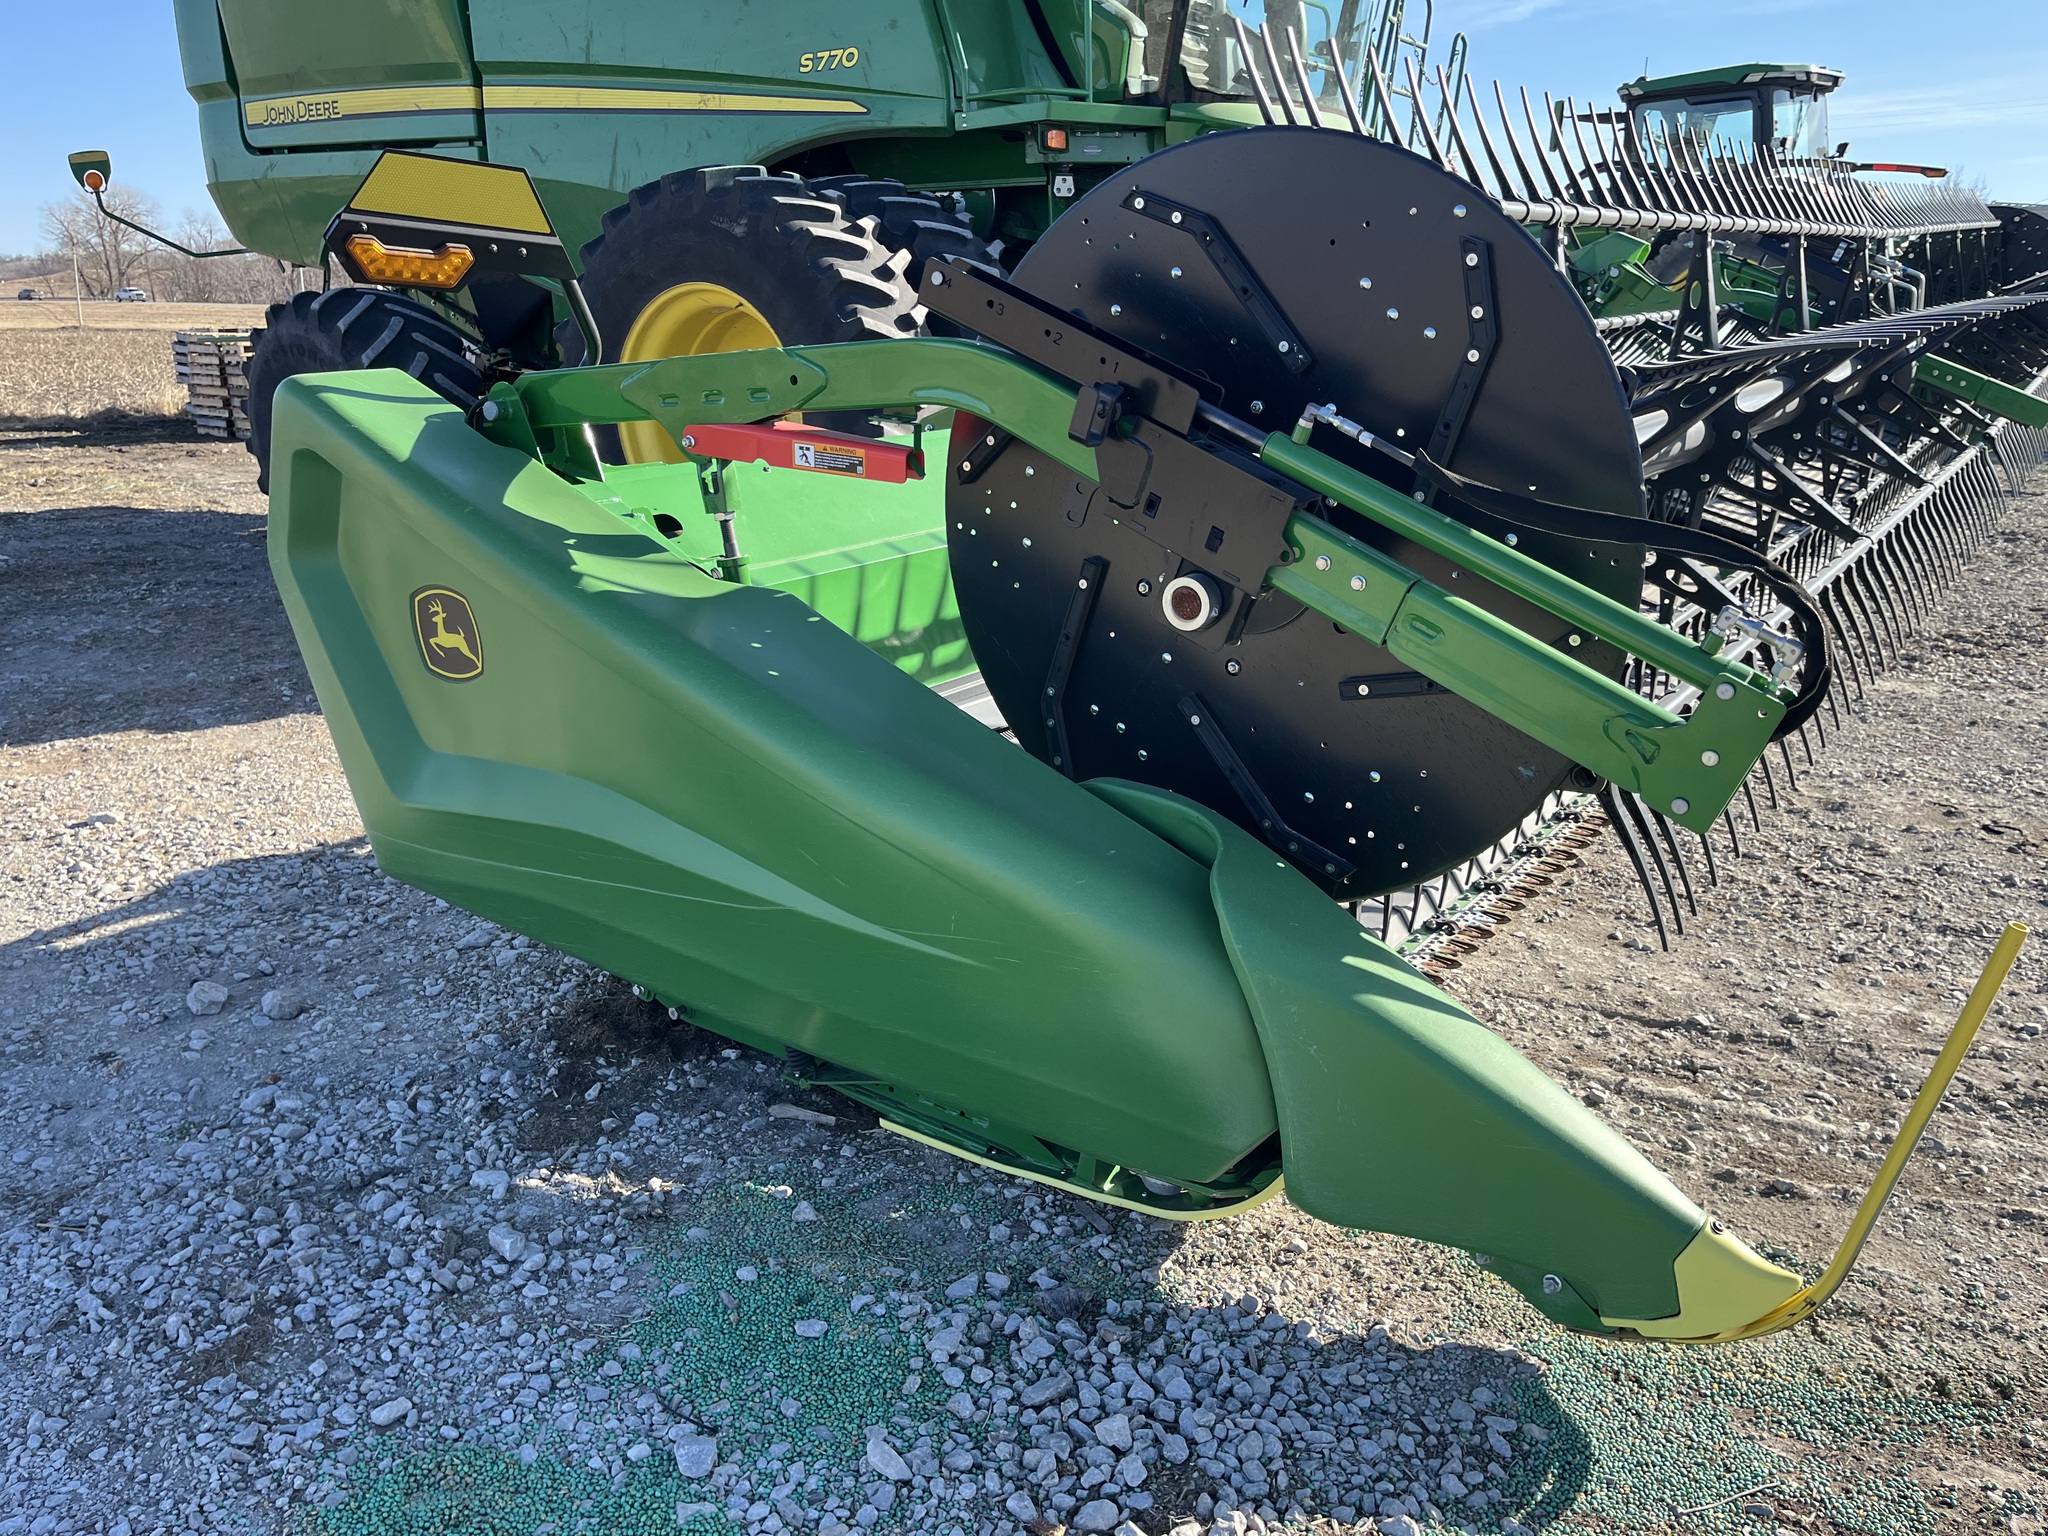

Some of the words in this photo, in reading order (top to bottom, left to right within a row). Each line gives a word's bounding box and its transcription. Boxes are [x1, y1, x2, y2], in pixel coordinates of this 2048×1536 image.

[799, 46, 860, 73] S770
[263, 105, 296, 123] JOHN
[296, 101, 341, 120] DEERE
[944, 277, 952, 289] 4
[995, 302, 1005, 316] 3
[1052, 332, 1063, 346] 2
[1113, 361, 1119, 374] 1
[829, 446, 857, 456] WARNING
